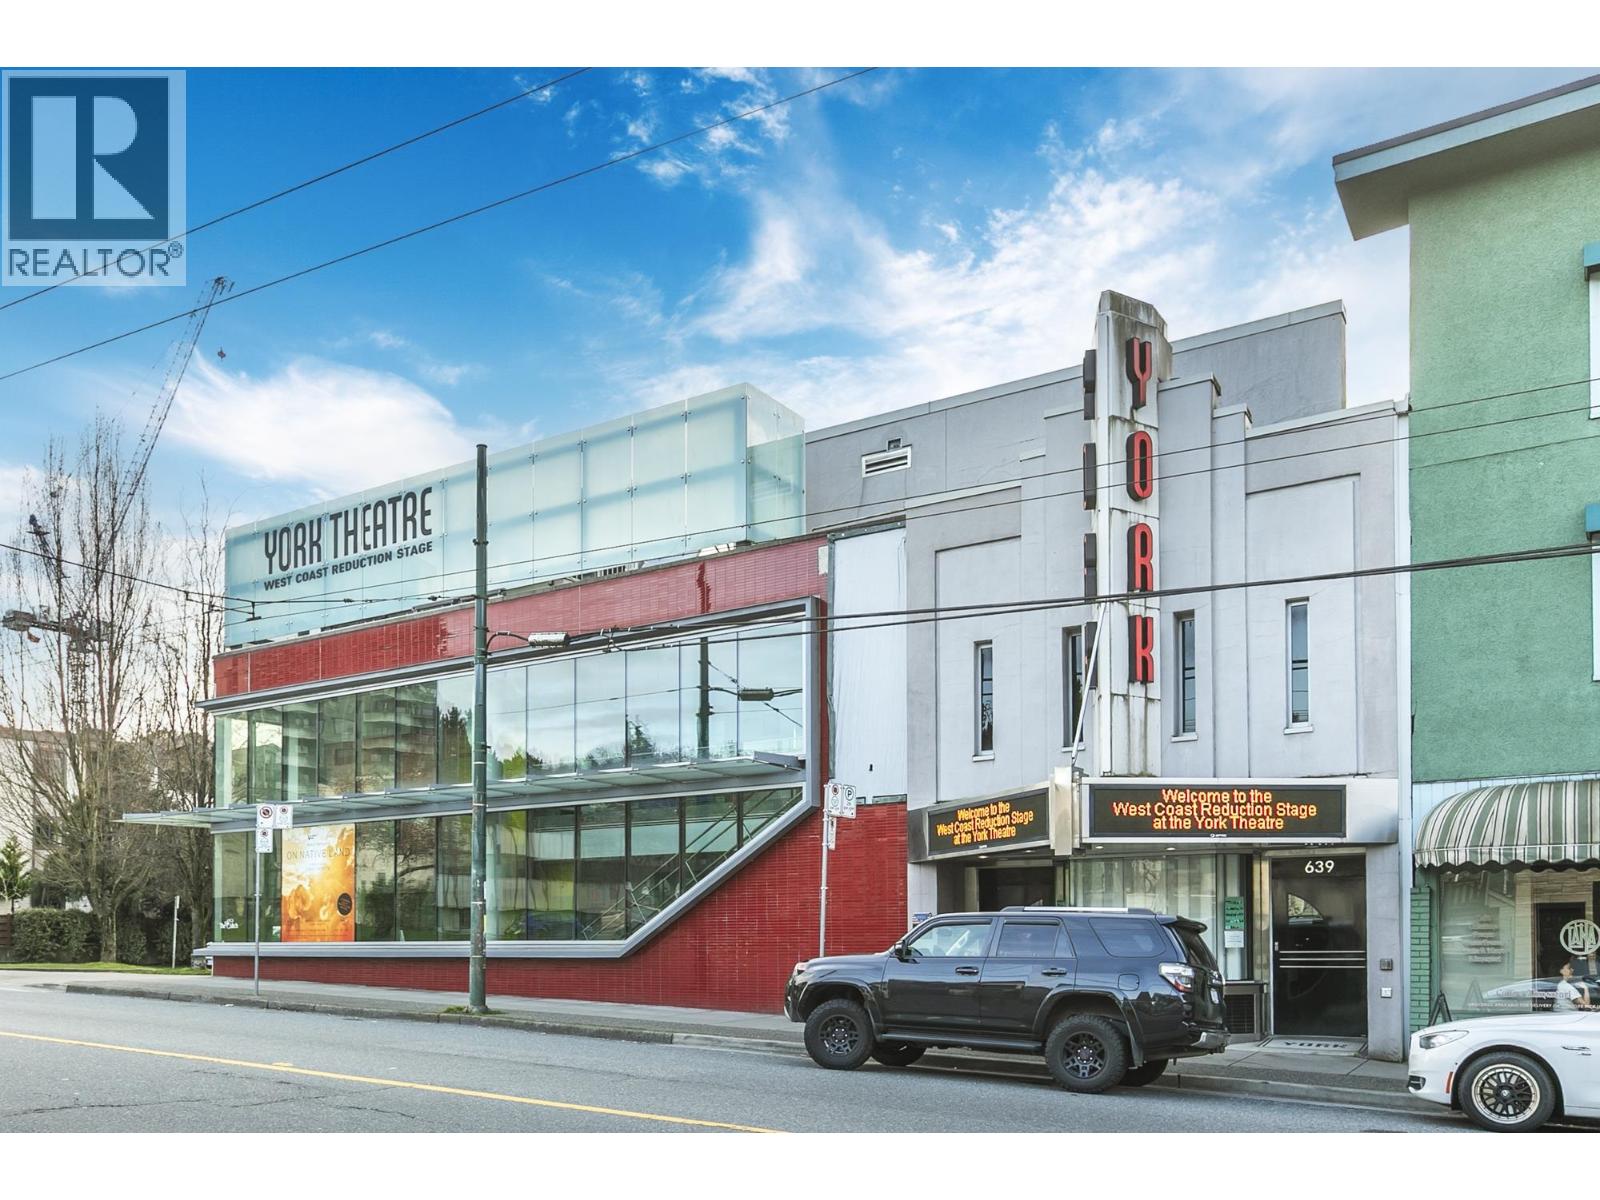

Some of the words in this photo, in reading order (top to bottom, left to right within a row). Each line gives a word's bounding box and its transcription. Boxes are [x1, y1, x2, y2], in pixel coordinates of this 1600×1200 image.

[1125, 336, 1154, 684] YORK
[264, 517, 322, 574] YORK
[330, 486, 433, 559] THEATRE
[264, 575, 293, 591] WEST
[295, 566, 329, 584] COAST
[331, 551, 392, 575] REDUCTION
[396, 541, 433, 559] STAGE
[1162, 788, 1230, 803] Welcome
[1233, 789, 1246, 803] to
[1249, 789, 1272, 803] the
[957, 806, 990, 821] Welcome
[990, 803, 997, 815] to
[998, 801, 1010, 814] the
[1113, 802, 1152, 817] West
[1154, 802, 1198, 817] Coast
[1200, 802, 1272, 817] Reduction
[1276, 802, 1317, 819] Stage
[936, 822, 954, 836] West
[954, 819, 974, 833] Coast
[974, 814, 1010, 830] Reduction
[1011, 810, 1034, 825] Stage
[1152, 816, 1166, 830] at
[1168, 816, 1192, 830] the
[1195, 816, 1227, 830] York
[1230, 815, 1284, 830] Theatre
[953, 834, 960, 845] at
[960, 831, 971, 844] the
[972, 830, 988, 843] York
[989, 825, 1016, 839] Theatre
[287, 851, 298, 860] ON
[299, 849, 326, 860] NATIVE
[328, 847, 351, 858] LAND
[1304, 860, 1335, 874] 639
